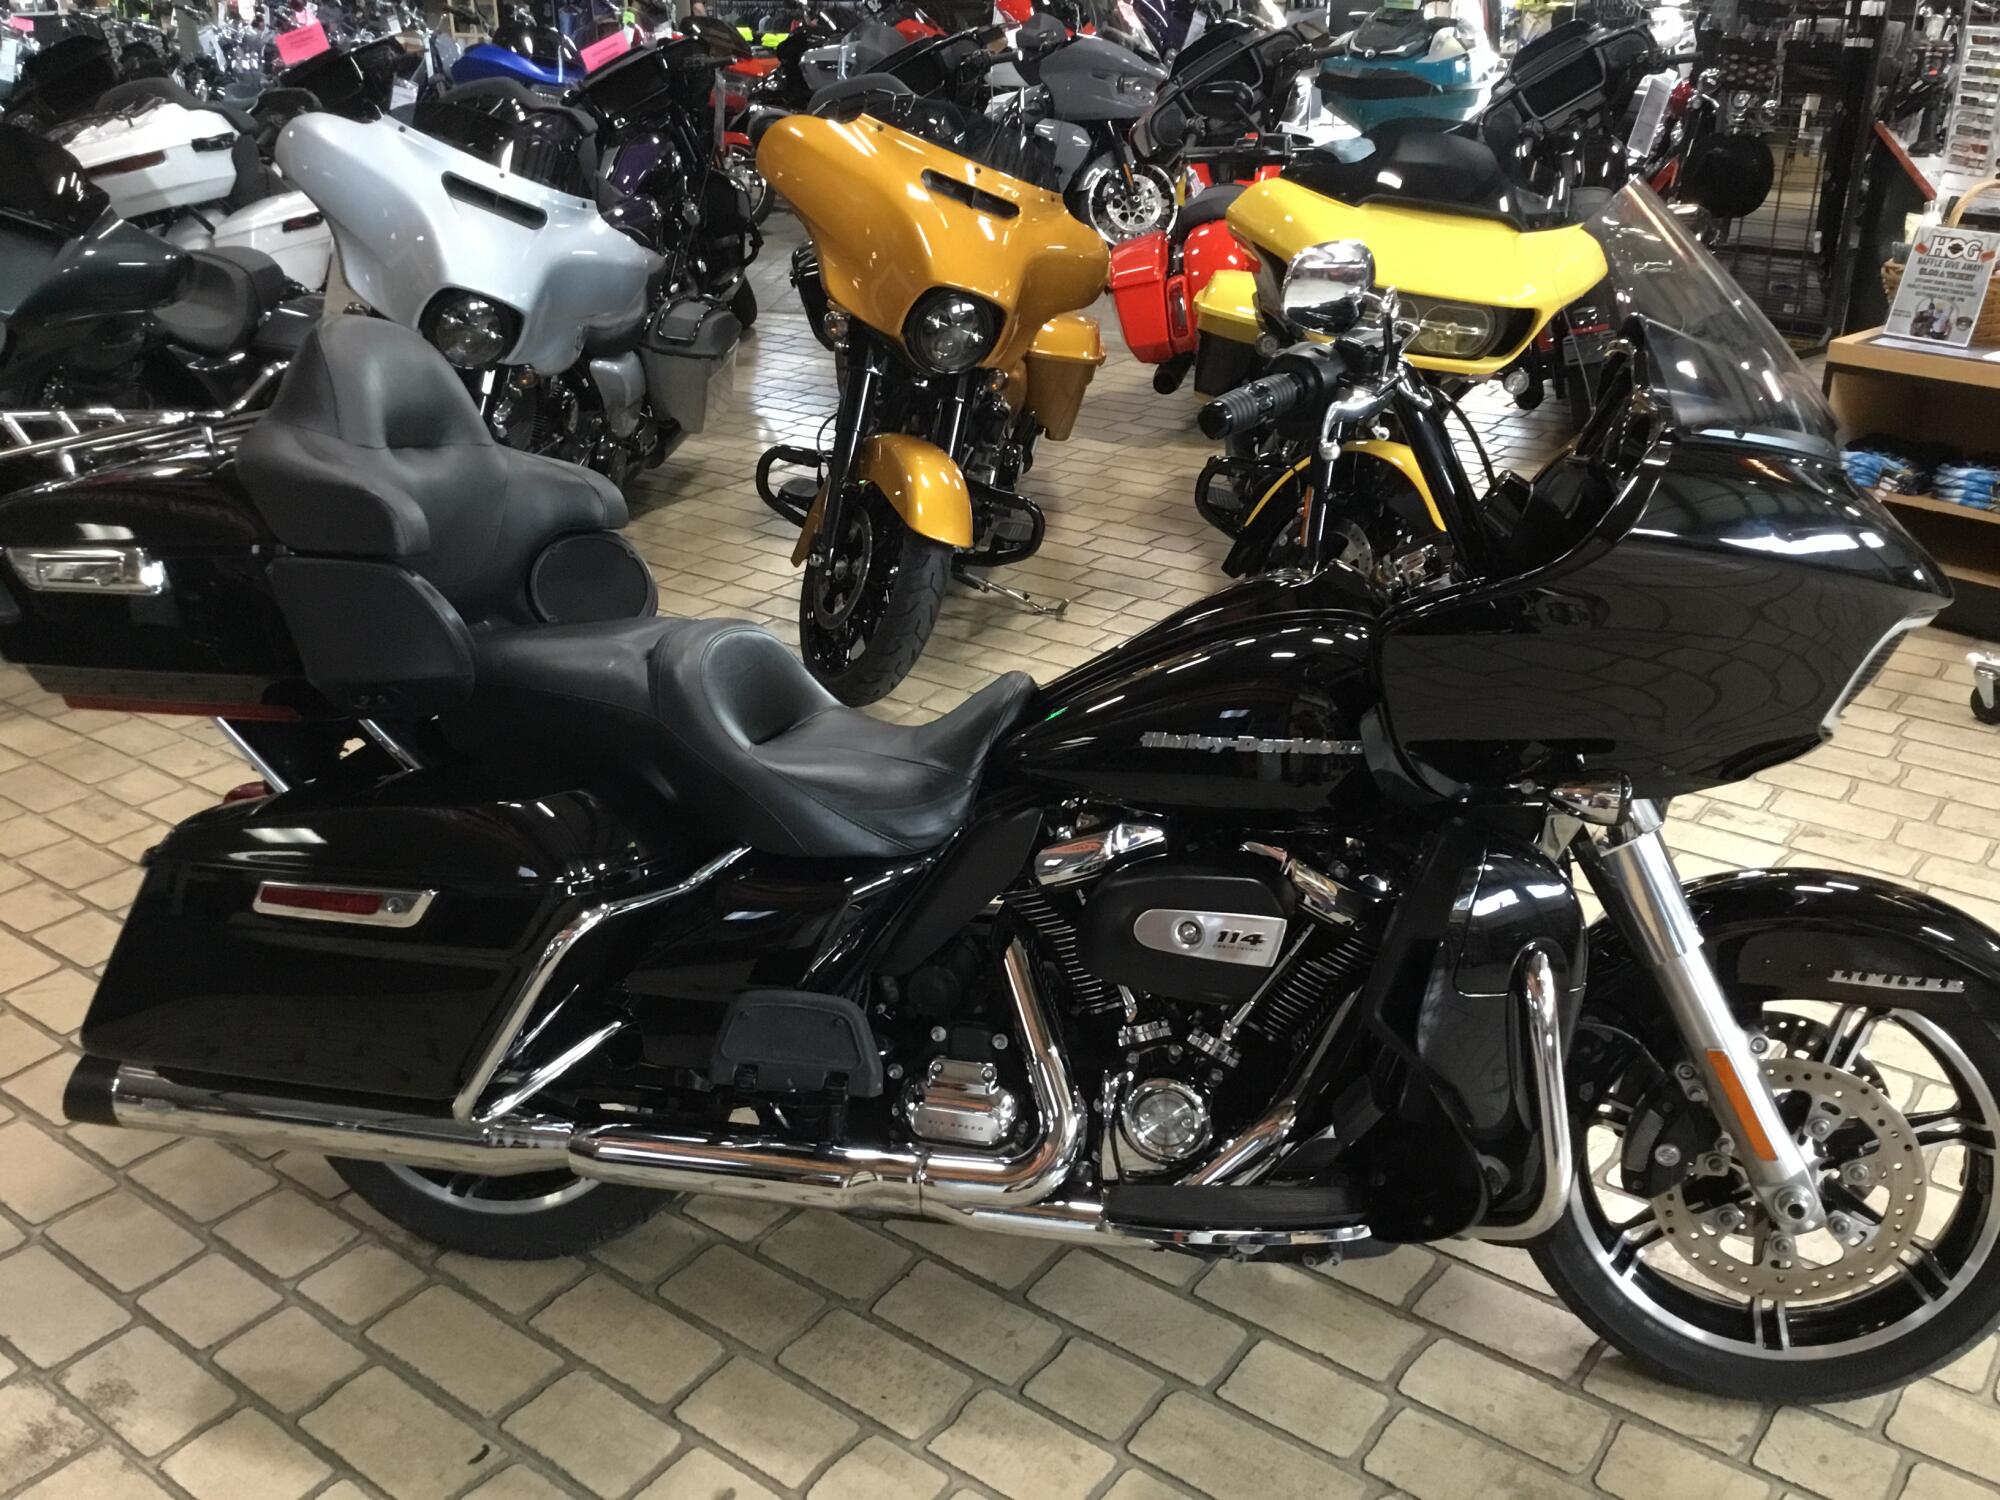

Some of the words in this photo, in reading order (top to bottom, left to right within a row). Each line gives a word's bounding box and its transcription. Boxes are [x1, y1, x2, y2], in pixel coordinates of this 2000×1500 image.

[1928, 235, 1983, 262] HOG
[1918, 257, 1943, 268] RAFFLE
[1139, 731, 1363, 754] Harley-Davidson
[1217, 930, 1266, 946] 114
[1827, 970, 1965, 993] LIMITED
